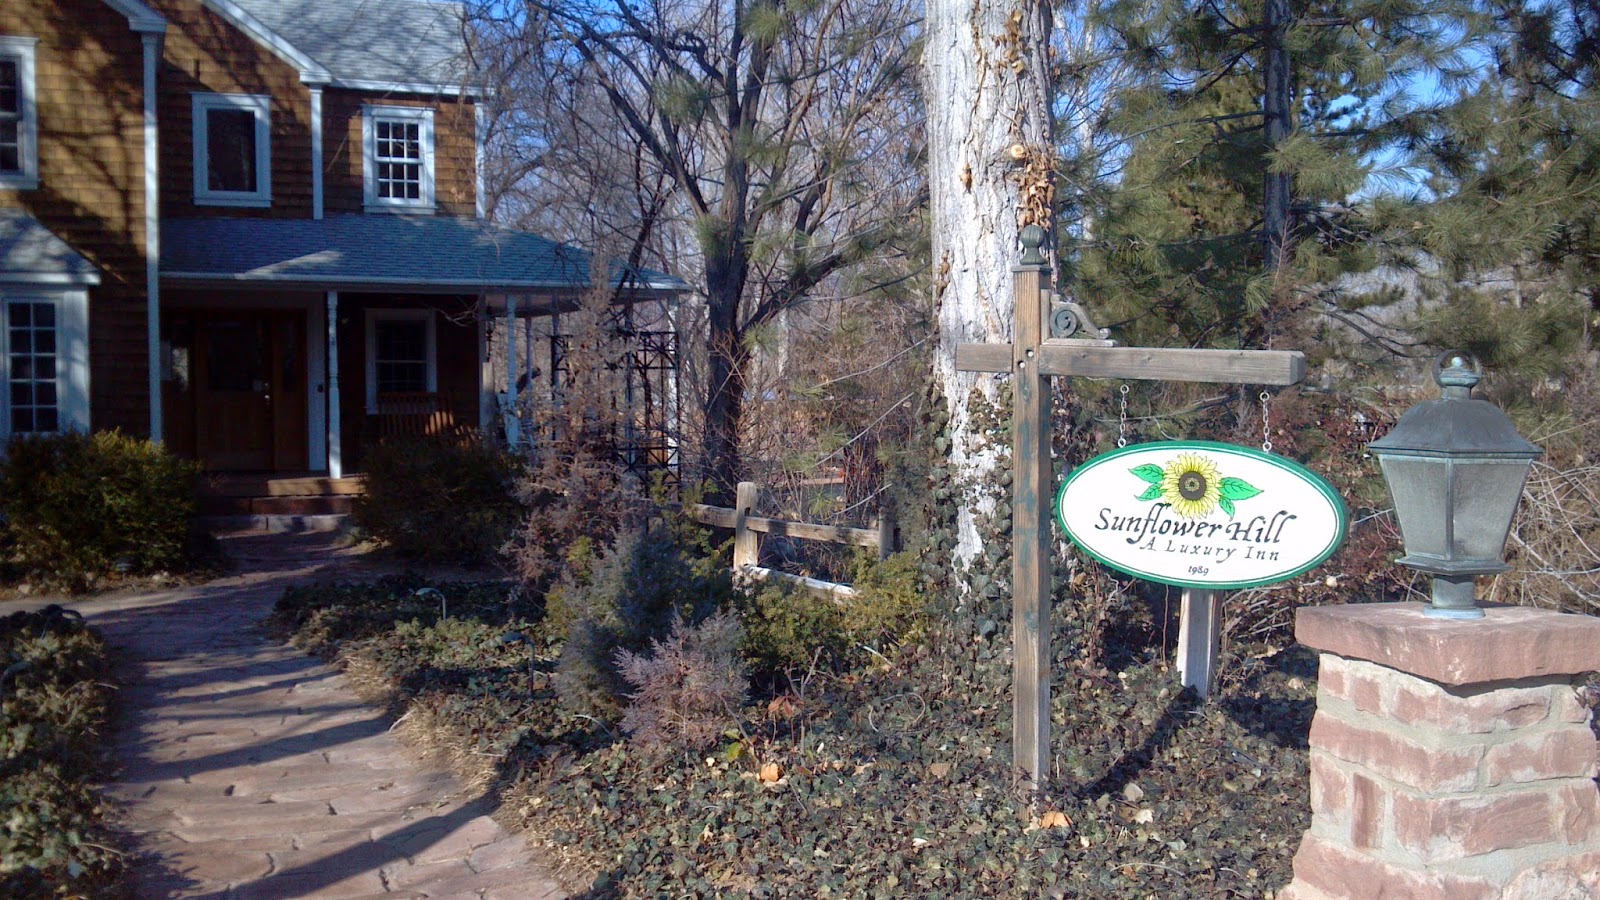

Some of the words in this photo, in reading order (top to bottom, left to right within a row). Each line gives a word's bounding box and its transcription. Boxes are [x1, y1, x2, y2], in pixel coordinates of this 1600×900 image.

[1094, 502, 1223, 544] Sunflower
[1226, 510, 1297, 544] Hill
[1139, 537, 1157, 551] A
[1165, 540, 1236, 563] Luxury
[1245, 546, 1280, 561] Inn
[1188, 565, 1209, 575] 1989
